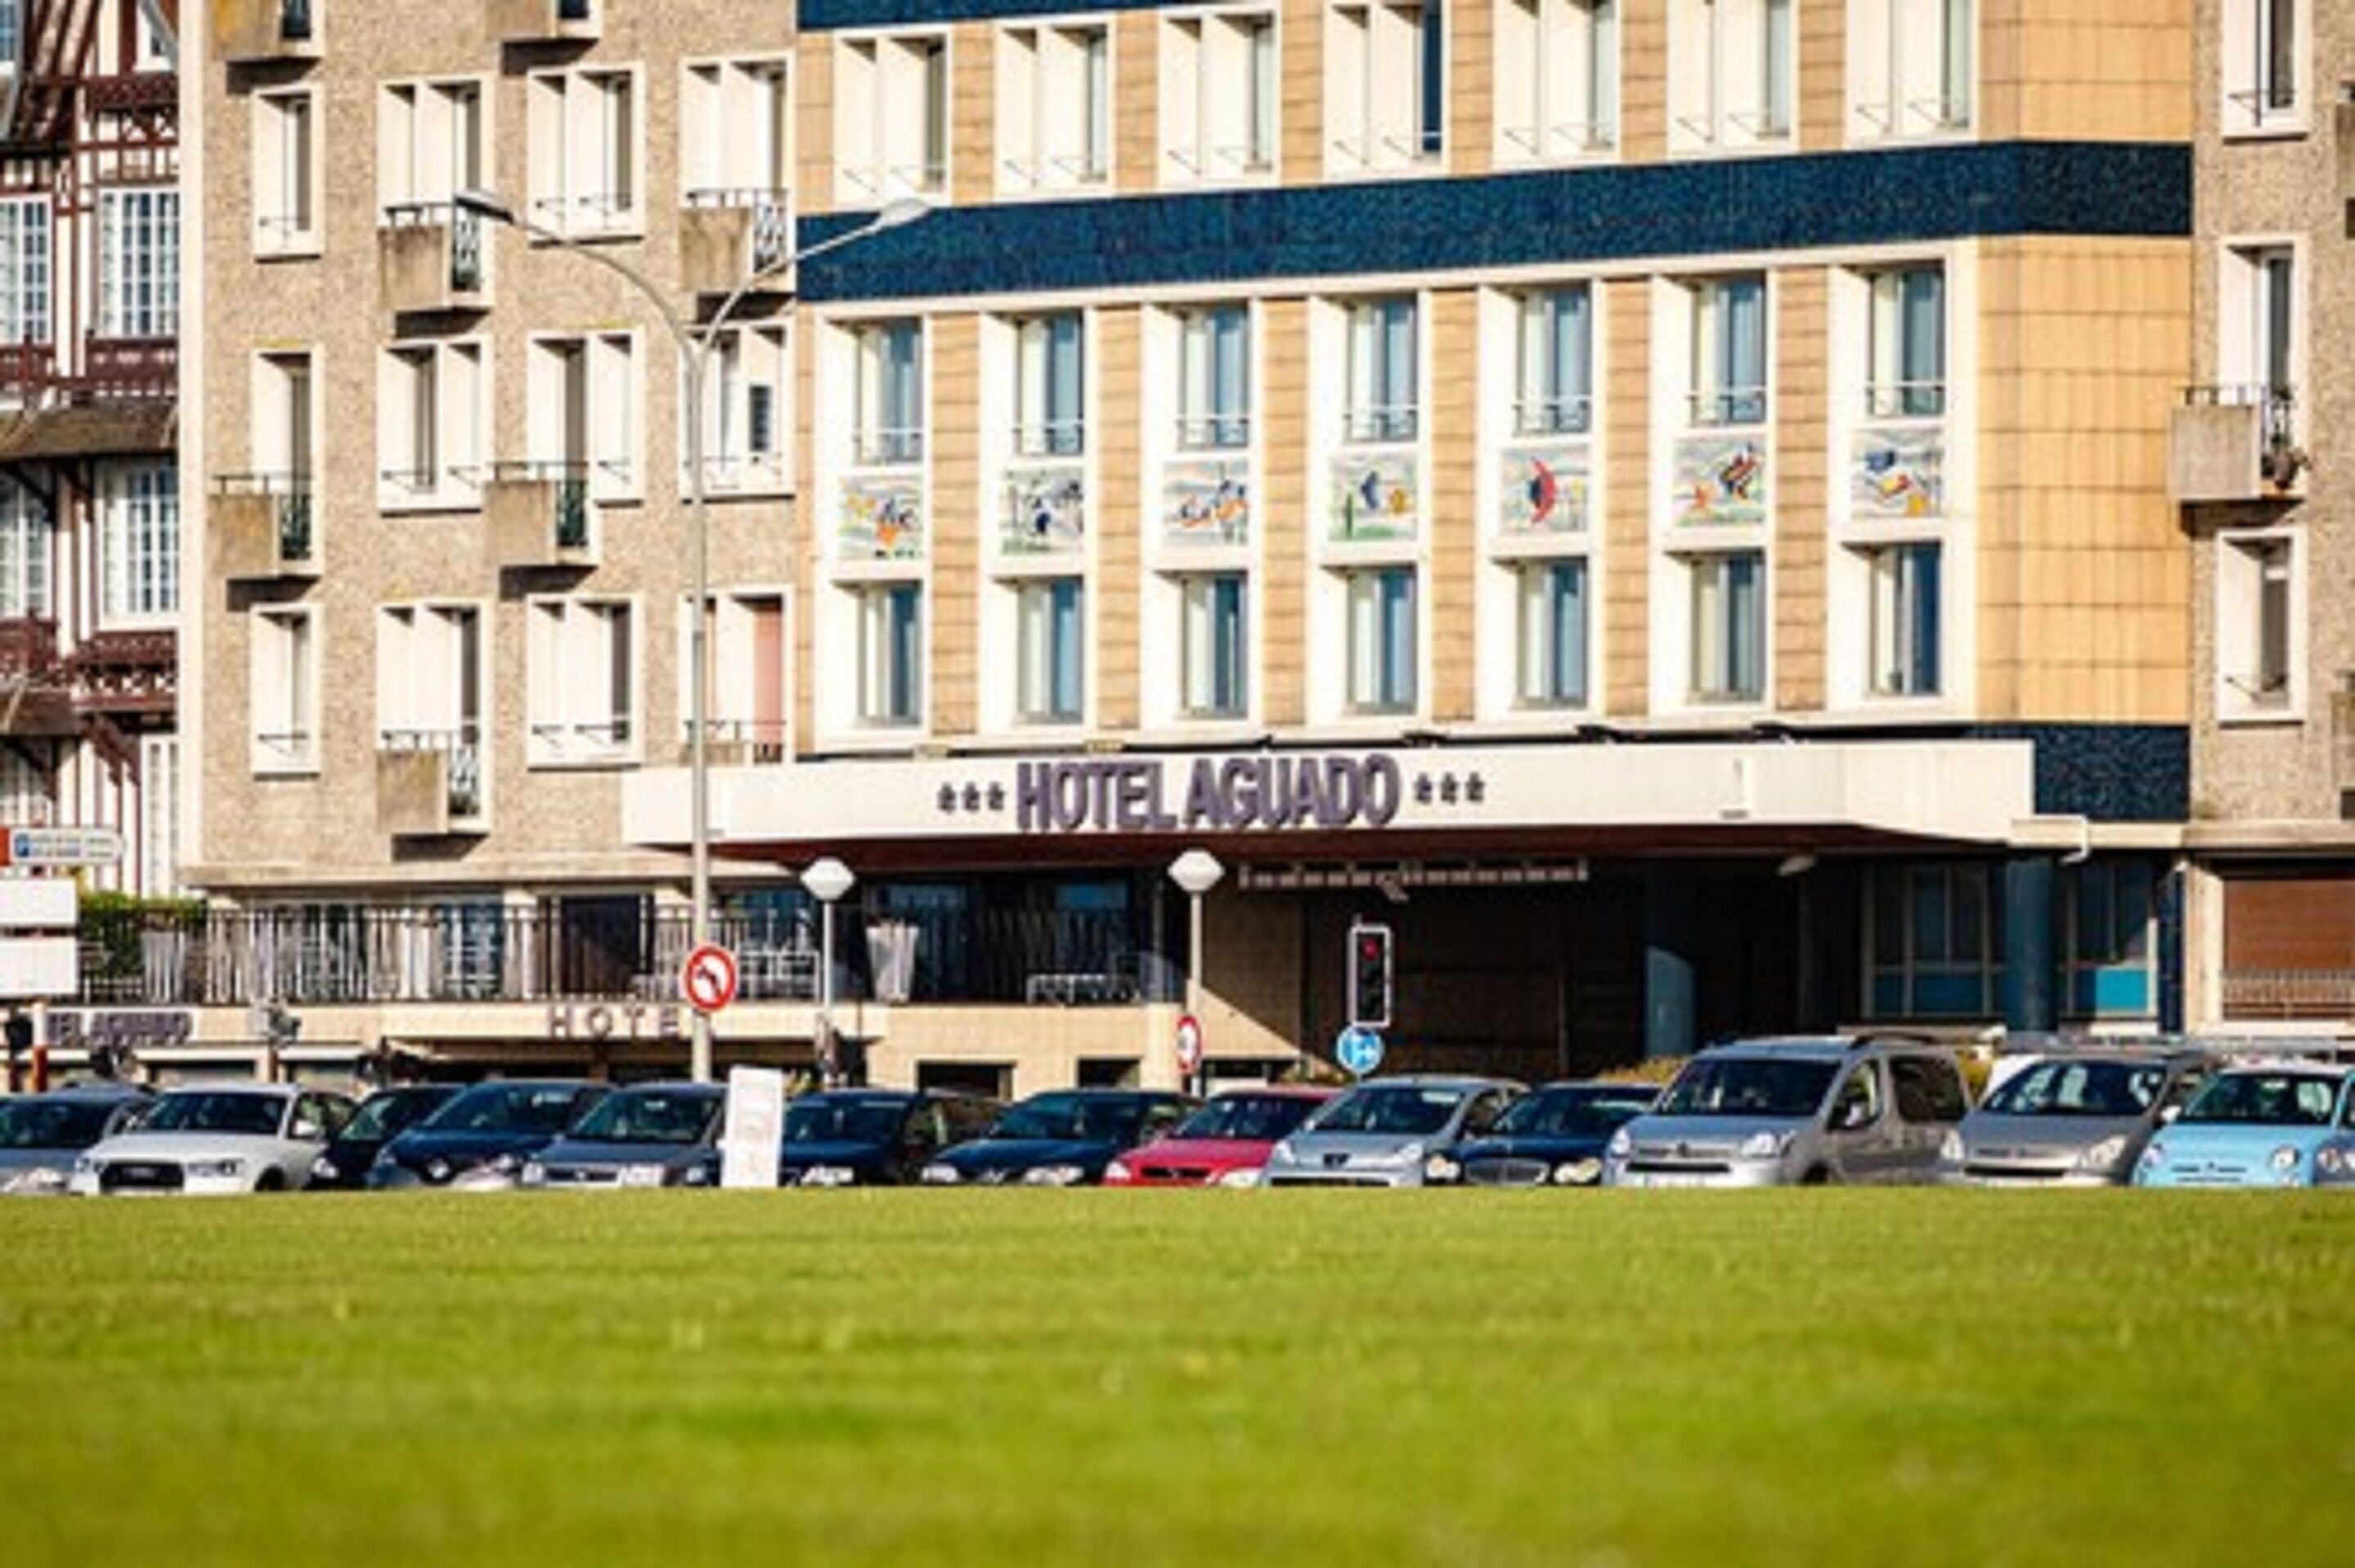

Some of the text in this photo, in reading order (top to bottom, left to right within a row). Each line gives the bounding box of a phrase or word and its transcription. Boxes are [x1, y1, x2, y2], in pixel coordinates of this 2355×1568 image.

[1017, 753, 1400, 830] HOTEL AGUADO
[549, 1003, 716, 1041] HOTE
